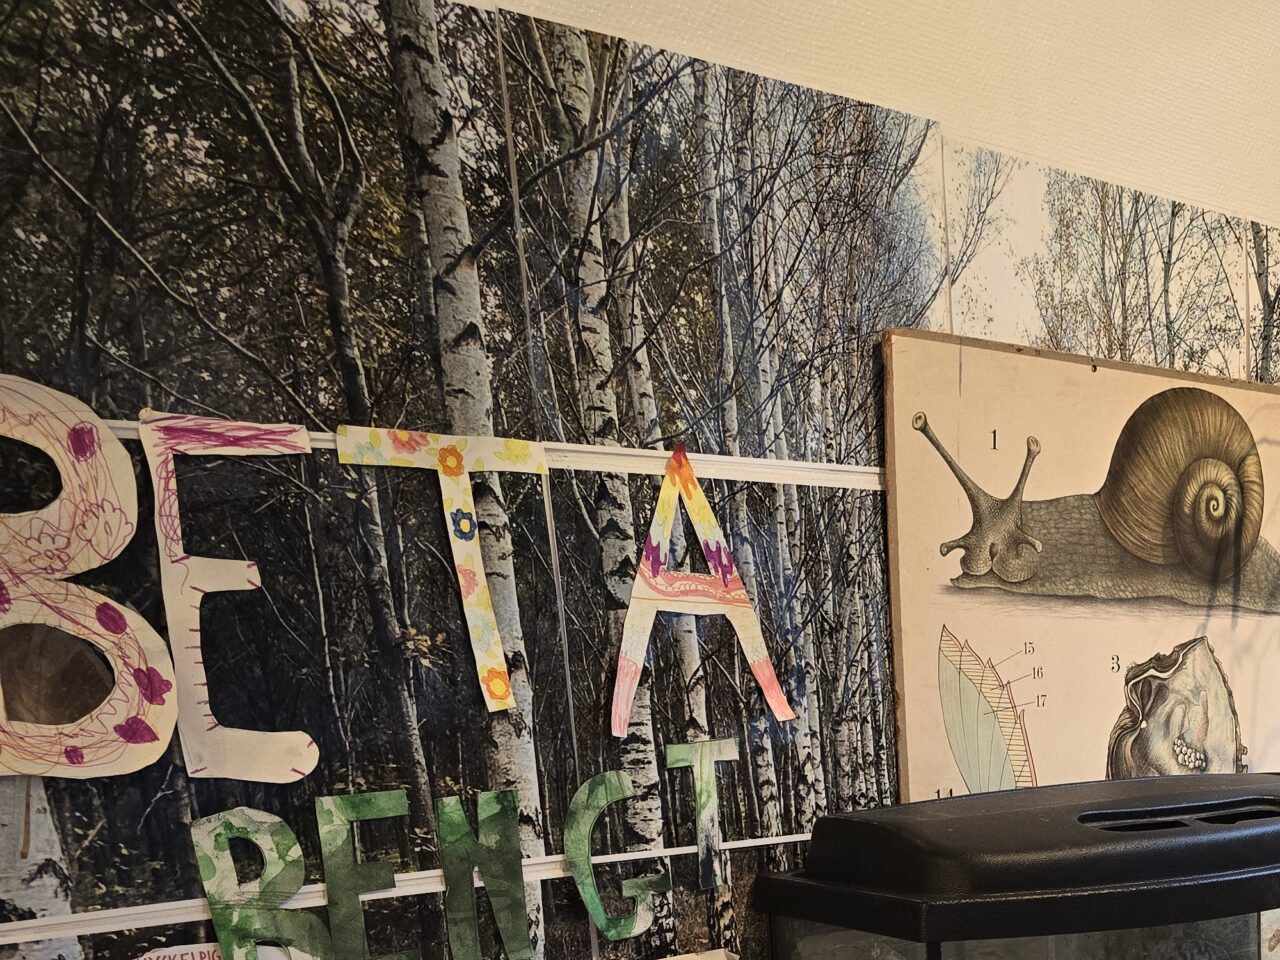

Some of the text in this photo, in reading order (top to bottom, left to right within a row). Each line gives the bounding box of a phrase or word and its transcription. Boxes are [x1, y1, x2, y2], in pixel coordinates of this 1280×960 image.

[990, 429, 999, 450] 1
[0, 373, 796, 783] BETA
[1023, 641, 1035, 655] 15
[1111, 654, 1120, 672] 3
[1032, 666, 1044, 679] 16
[1036, 694, 1047, 708] 17
